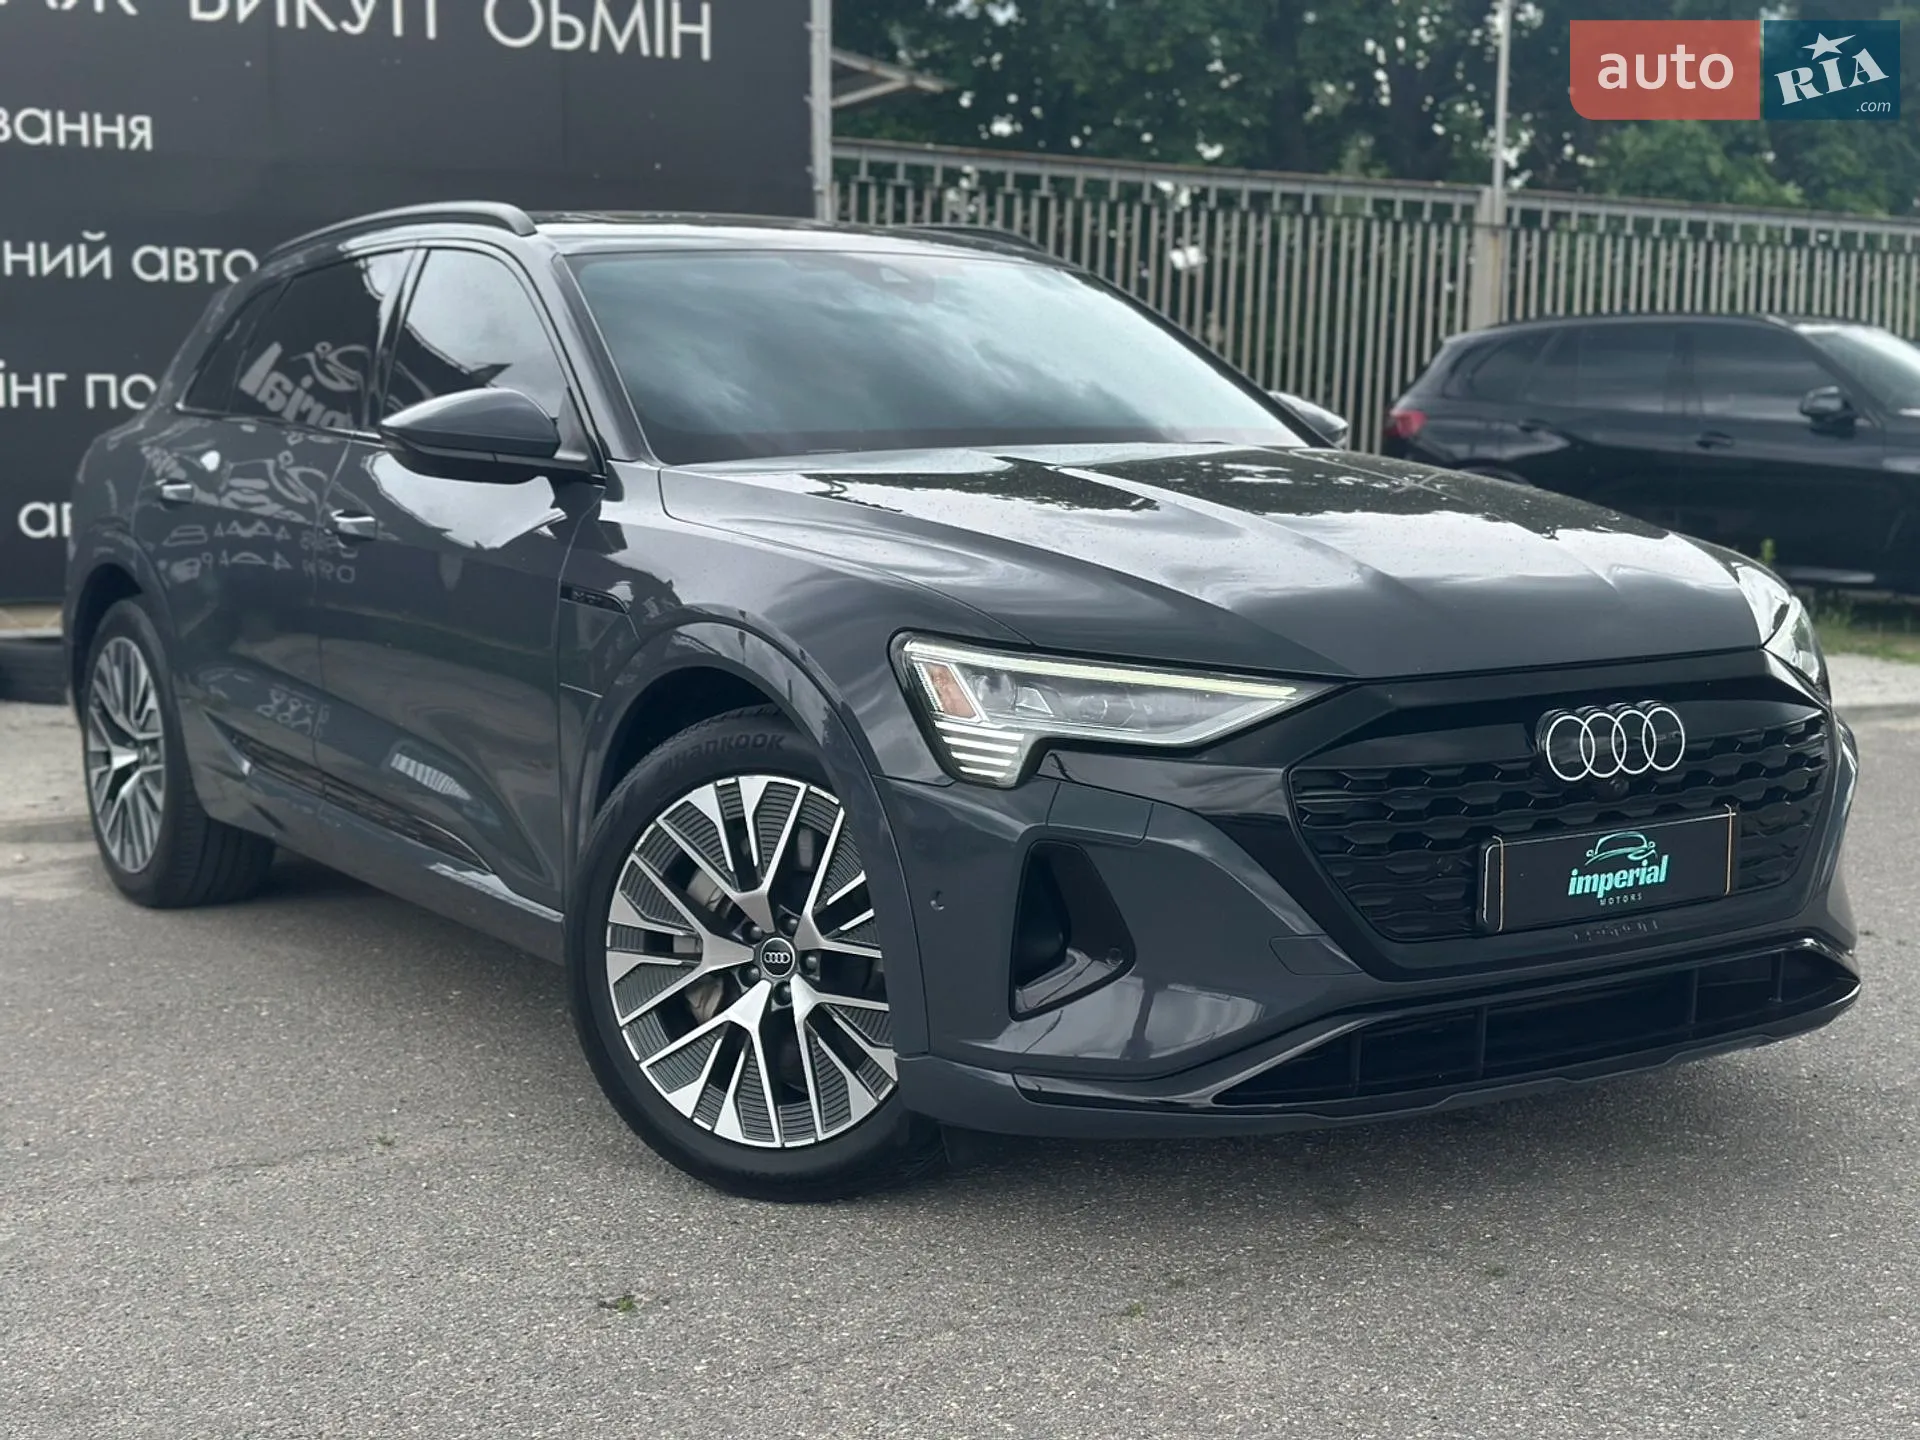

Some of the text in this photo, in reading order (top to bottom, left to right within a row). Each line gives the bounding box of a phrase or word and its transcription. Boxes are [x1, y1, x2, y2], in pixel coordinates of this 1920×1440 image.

[131, 244, 259, 283] авто
[1567, 854, 1669, 899] imperial
[1600, 892, 1643, 905] MOTORS
